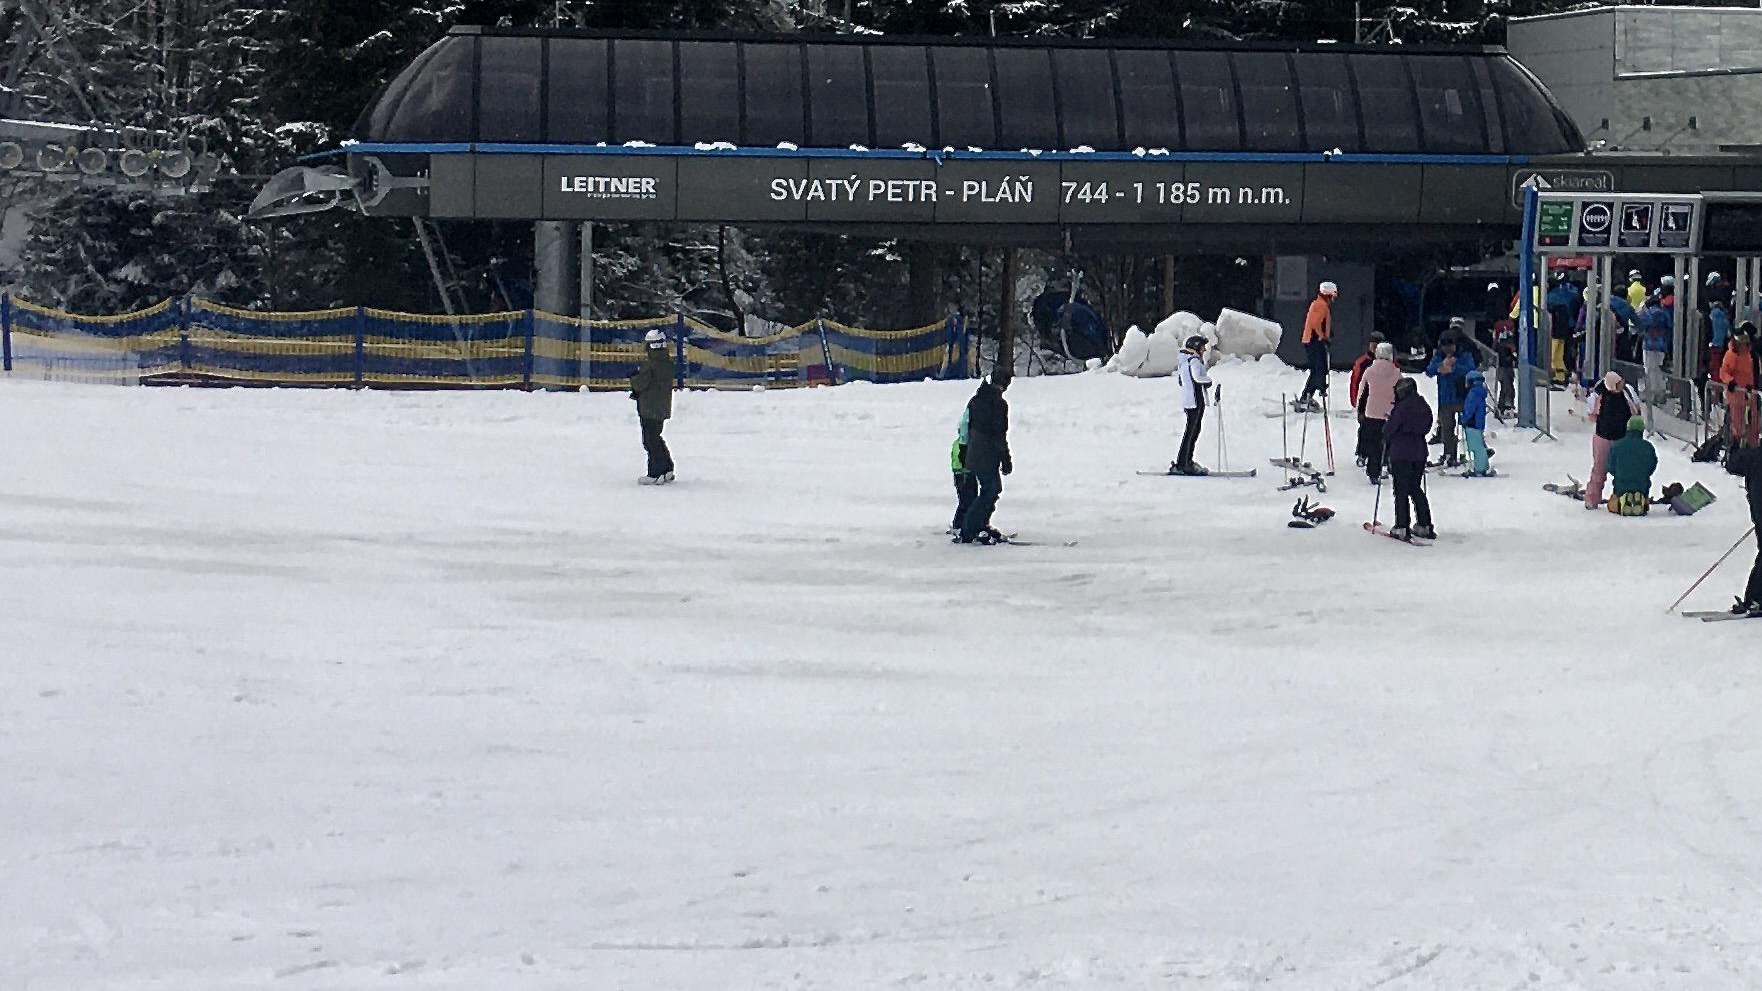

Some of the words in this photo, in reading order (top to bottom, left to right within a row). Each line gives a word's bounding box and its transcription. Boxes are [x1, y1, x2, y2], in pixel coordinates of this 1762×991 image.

[561, 176, 656, 193] LEITNER
[770, 174, 861, 201] SVATÝ
[868, 179, 937, 202] PETR
[962, 175, 1033, 203] PLÁŇ
[1061, 181, 1109, 204] 744
[1156, 182, 1201, 204] 185
[1208, 187, 1230, 204] m
[1238, 187, 1291, 204] n.m.
